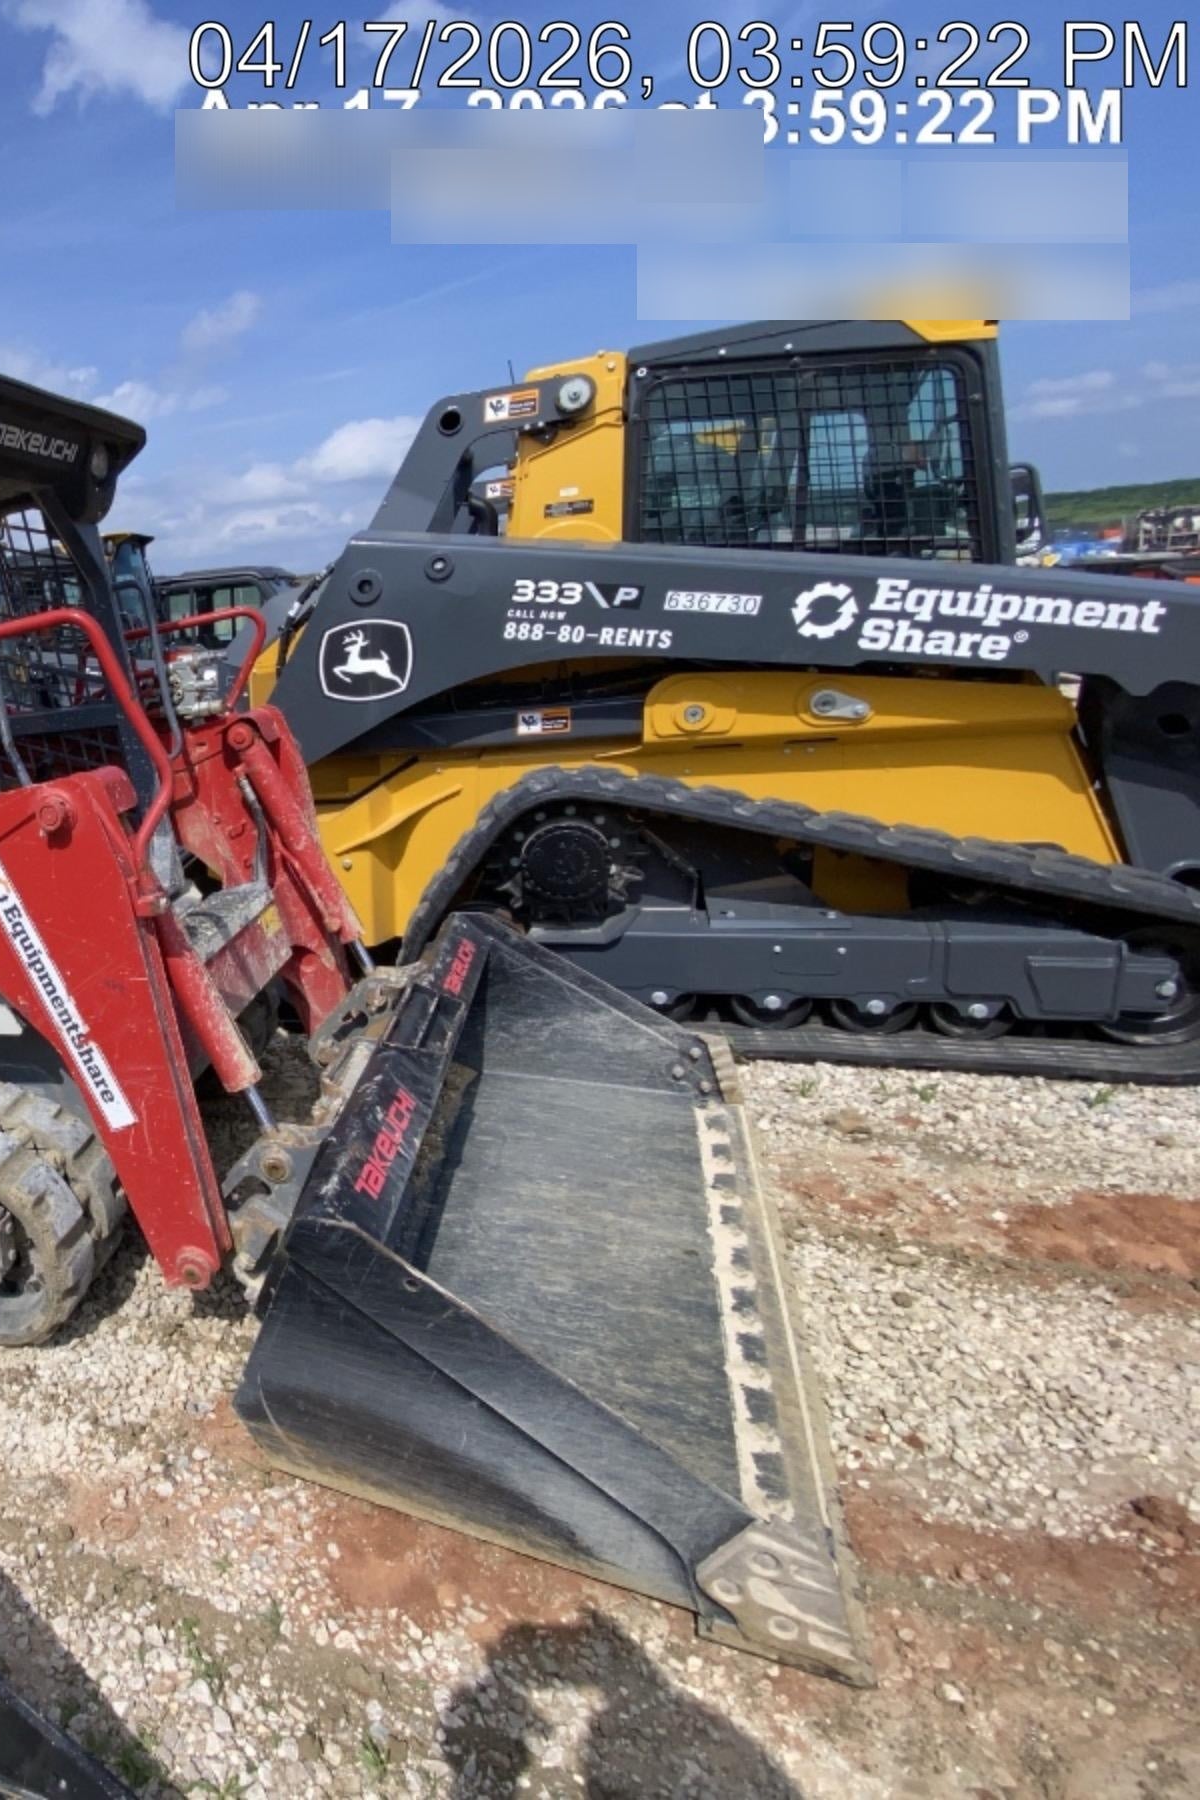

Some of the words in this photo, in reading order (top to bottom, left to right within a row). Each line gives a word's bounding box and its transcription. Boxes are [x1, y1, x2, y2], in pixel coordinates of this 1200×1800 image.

[512, 579, 583, 605] 333
[667, 592, 758, 614] 636730
[507, 609, 535, 619] CALL
[539, 610, 567, 620] NOW
[869, 577, 1167, 634] Equipment
[503, 622, 673, 649] 888-80-RENTS
[2, 903, 116, 1105] EquipmentShare
